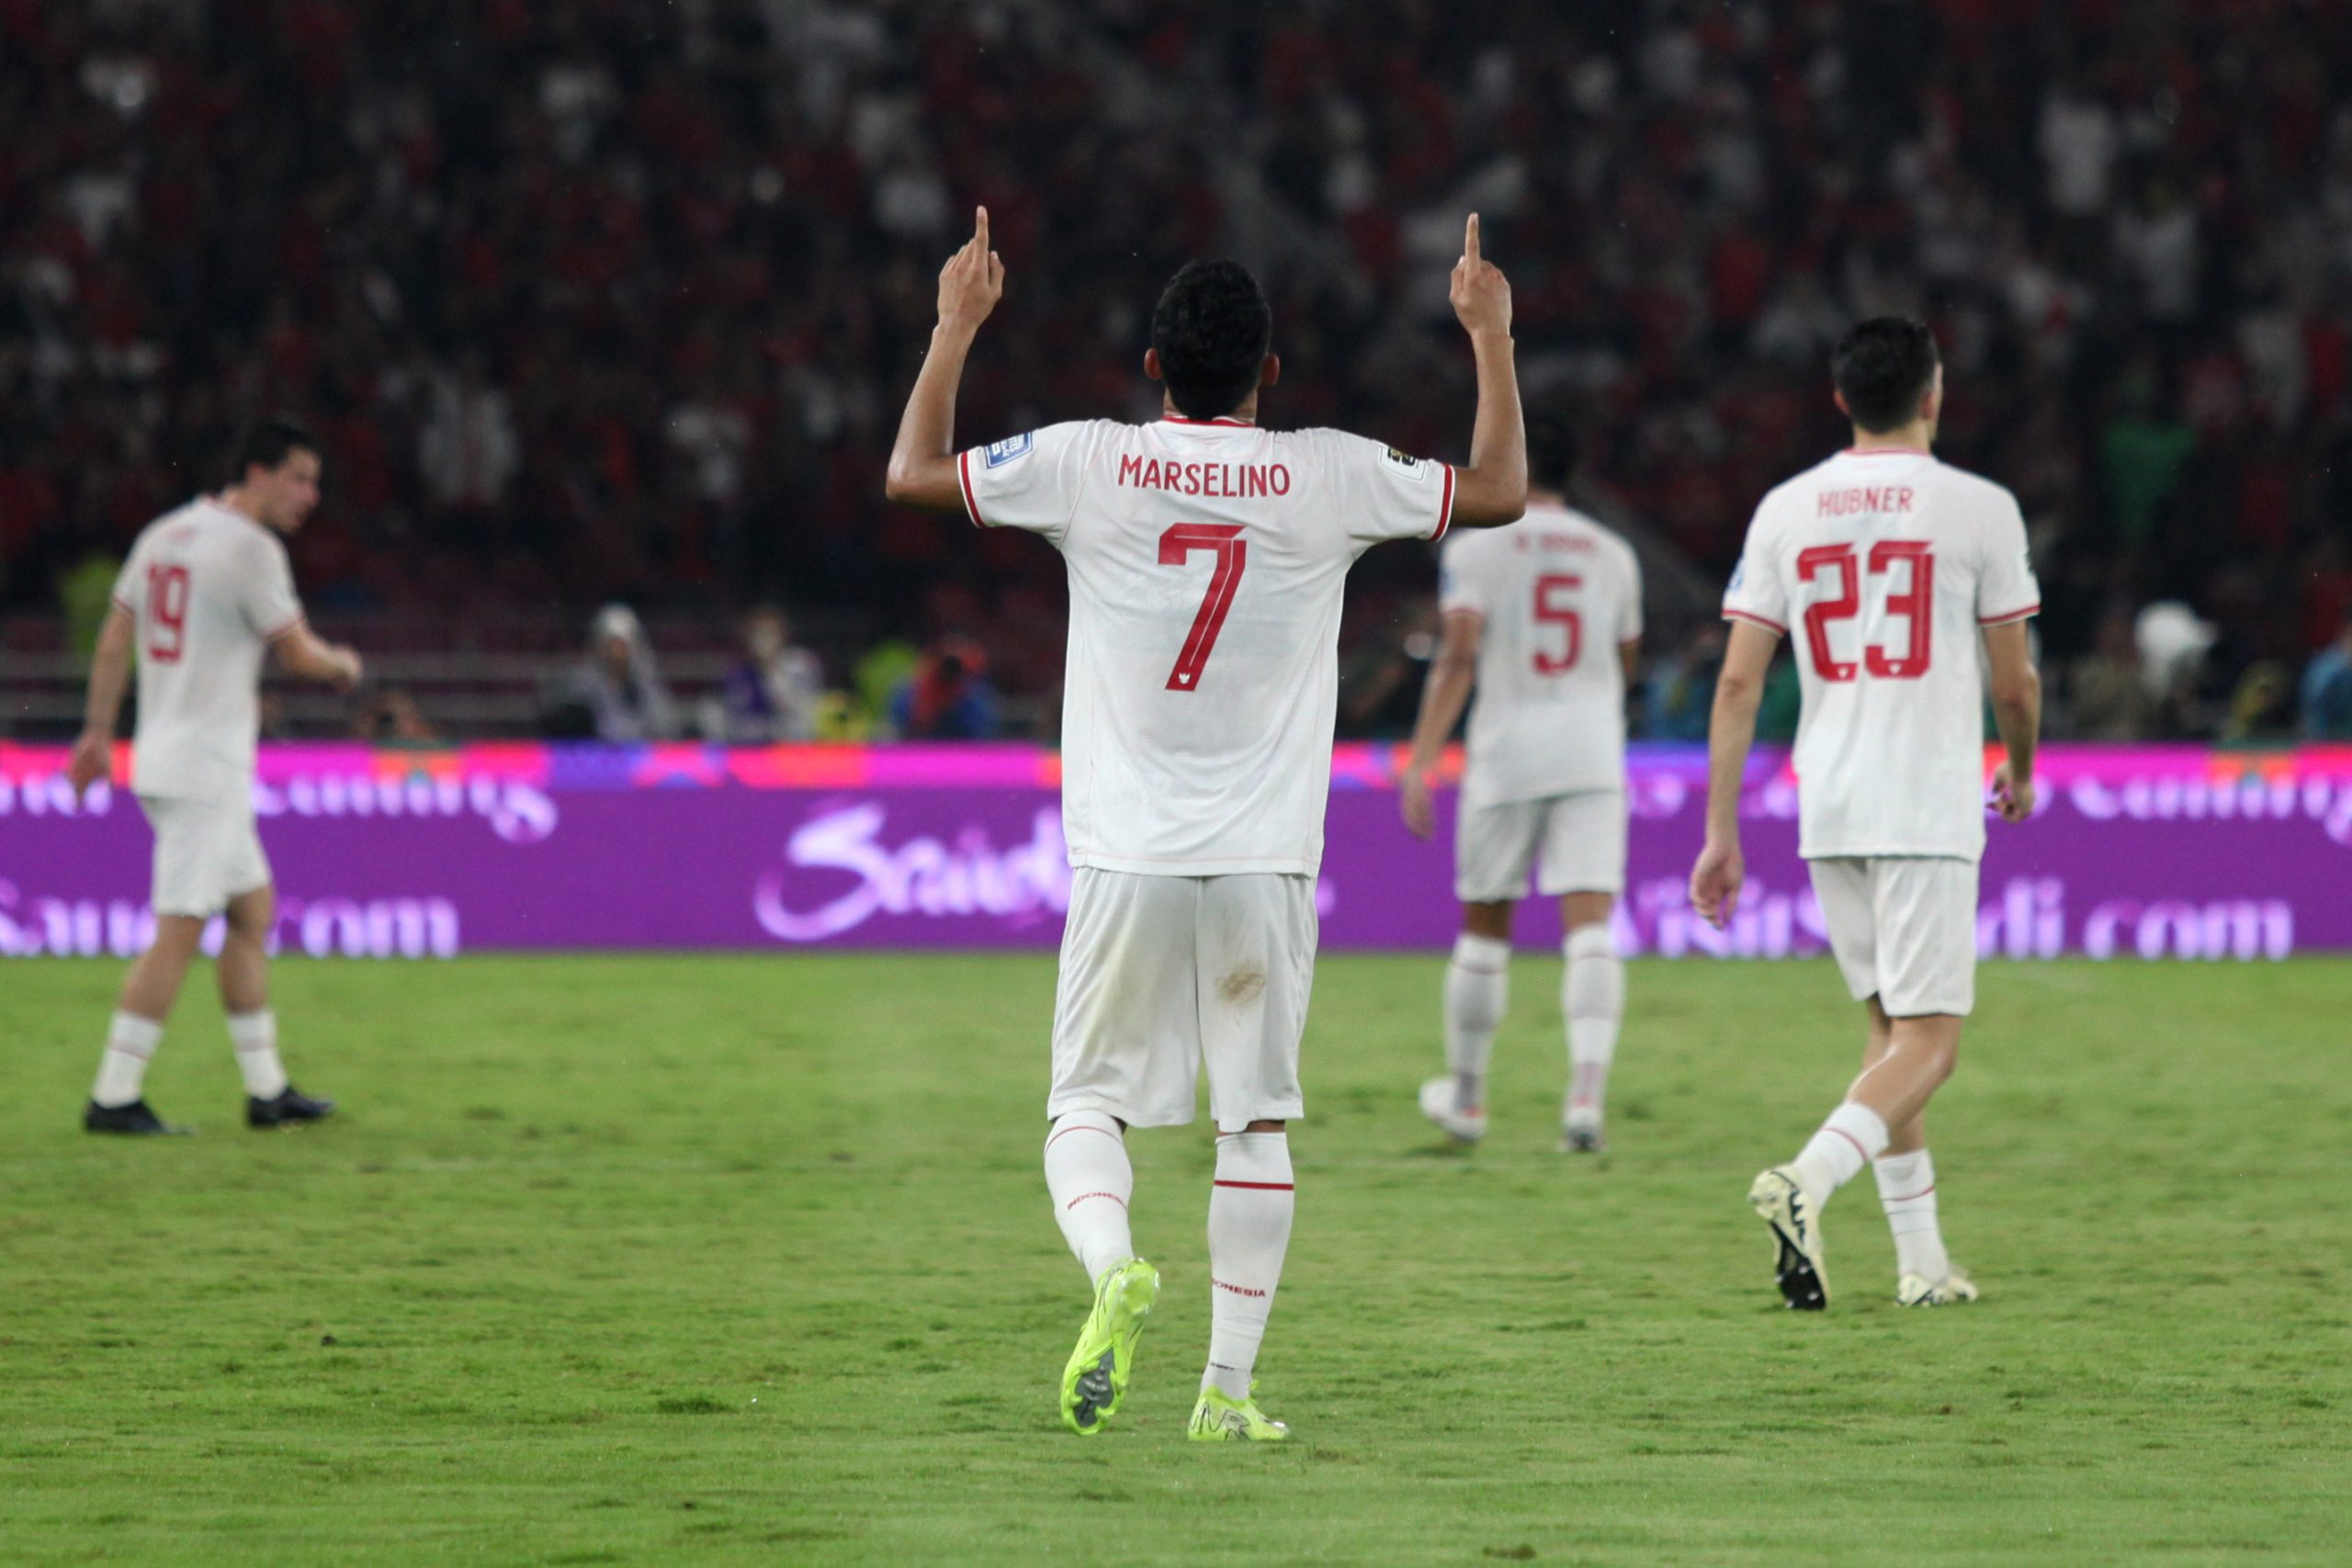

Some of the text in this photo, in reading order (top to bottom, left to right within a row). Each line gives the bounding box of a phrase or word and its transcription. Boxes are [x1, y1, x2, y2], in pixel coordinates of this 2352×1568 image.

[1118, 454, 1291, 498] MARSELINO
[1817, 486, 1915, 518] HUBNER
[147, 563, 190, 664] 19
[1158, 522, 1248, 692] 7
[1532, 573, 1583, 676] 5
[1796, 539, 1935, 683] 23
